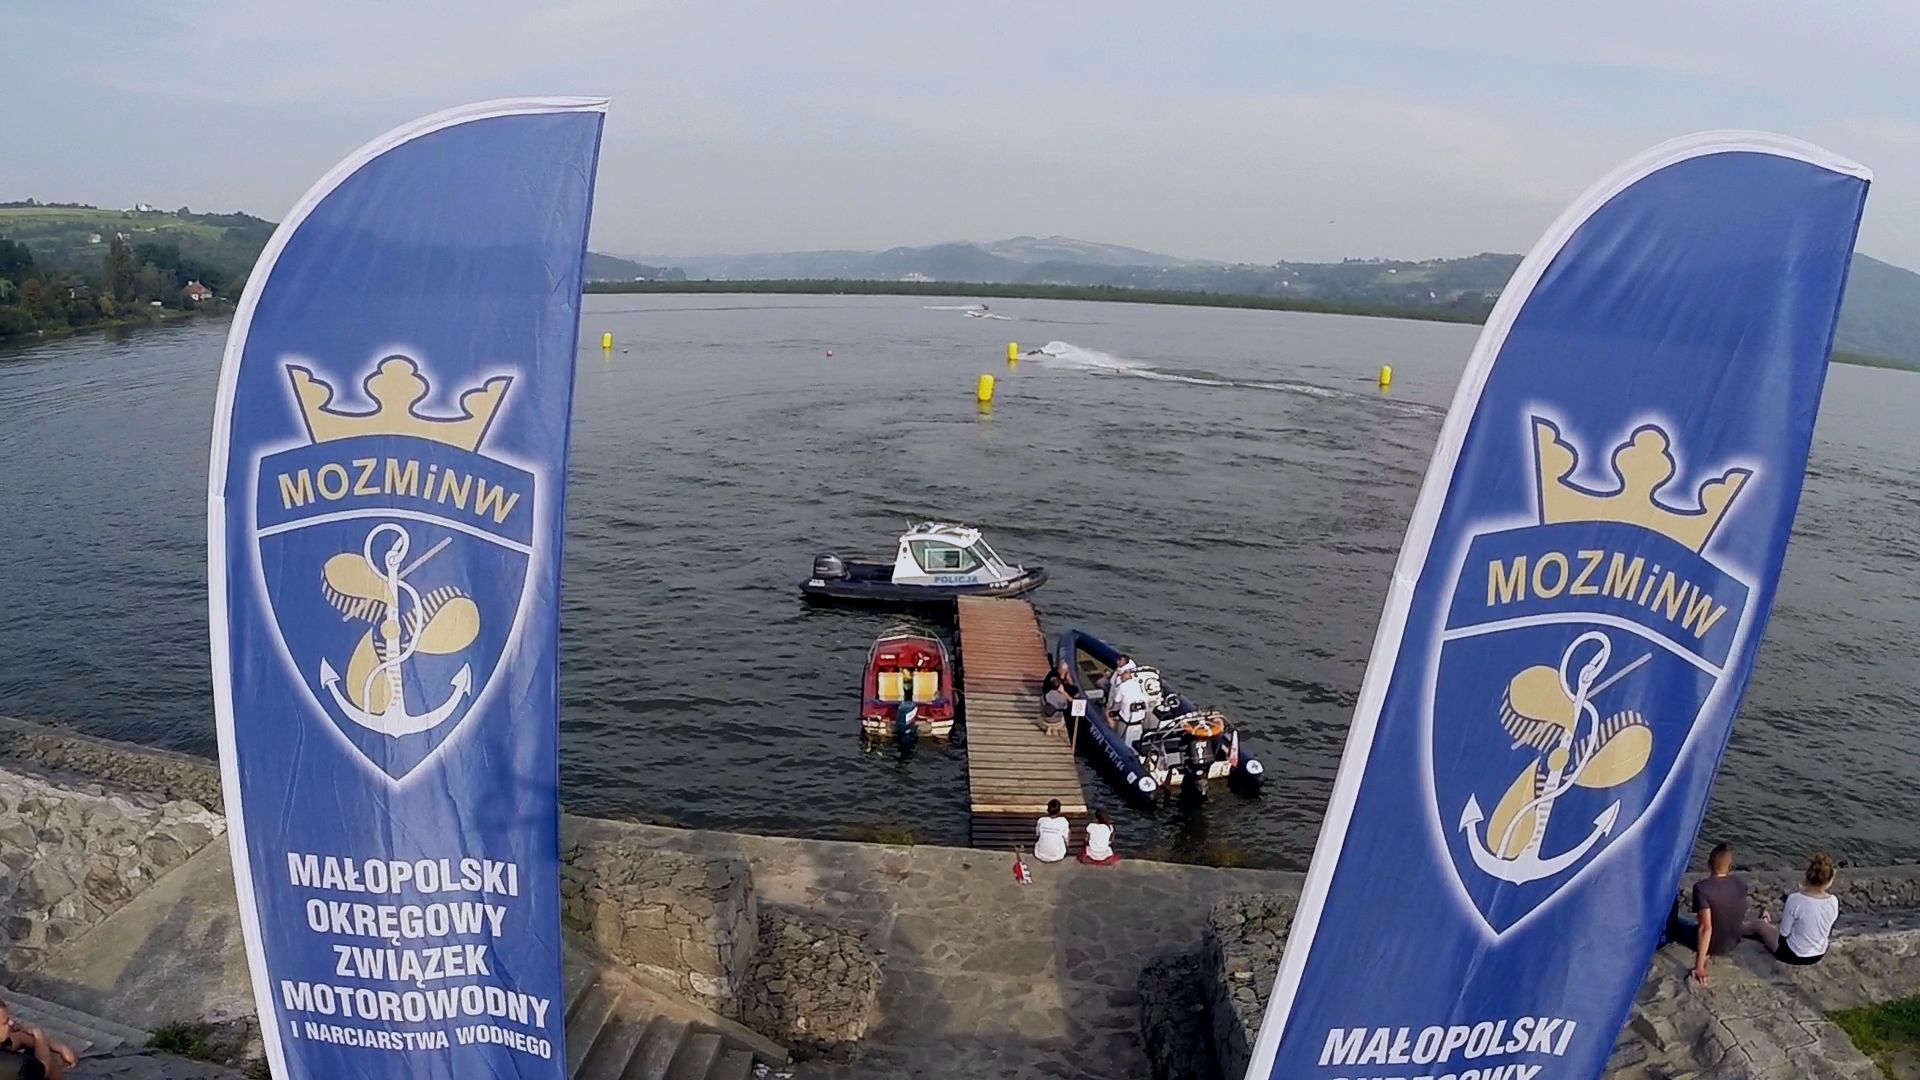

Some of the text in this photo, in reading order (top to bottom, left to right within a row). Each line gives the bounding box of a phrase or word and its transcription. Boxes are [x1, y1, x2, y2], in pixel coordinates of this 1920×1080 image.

[277, 458, 520, 524] MOZMiNW
[934, 575, 979, 584] POLICJA
[1487, 550, 1728, 639] MOZMiNW
[287, 852, 519, 897] MAŁOPOLSKI
[306, 898, 507, 946] OKRĘGOWY
[333, 944, 490, 989] ZWIĄZEK
[280, 980, 551, 1029] MOTOROWODNY
[291, 1020, 552, 1060] I NARCIARSTWA WODNEGO
[1318, 1016, 1577, 1066] MAŁOPOLSKI
